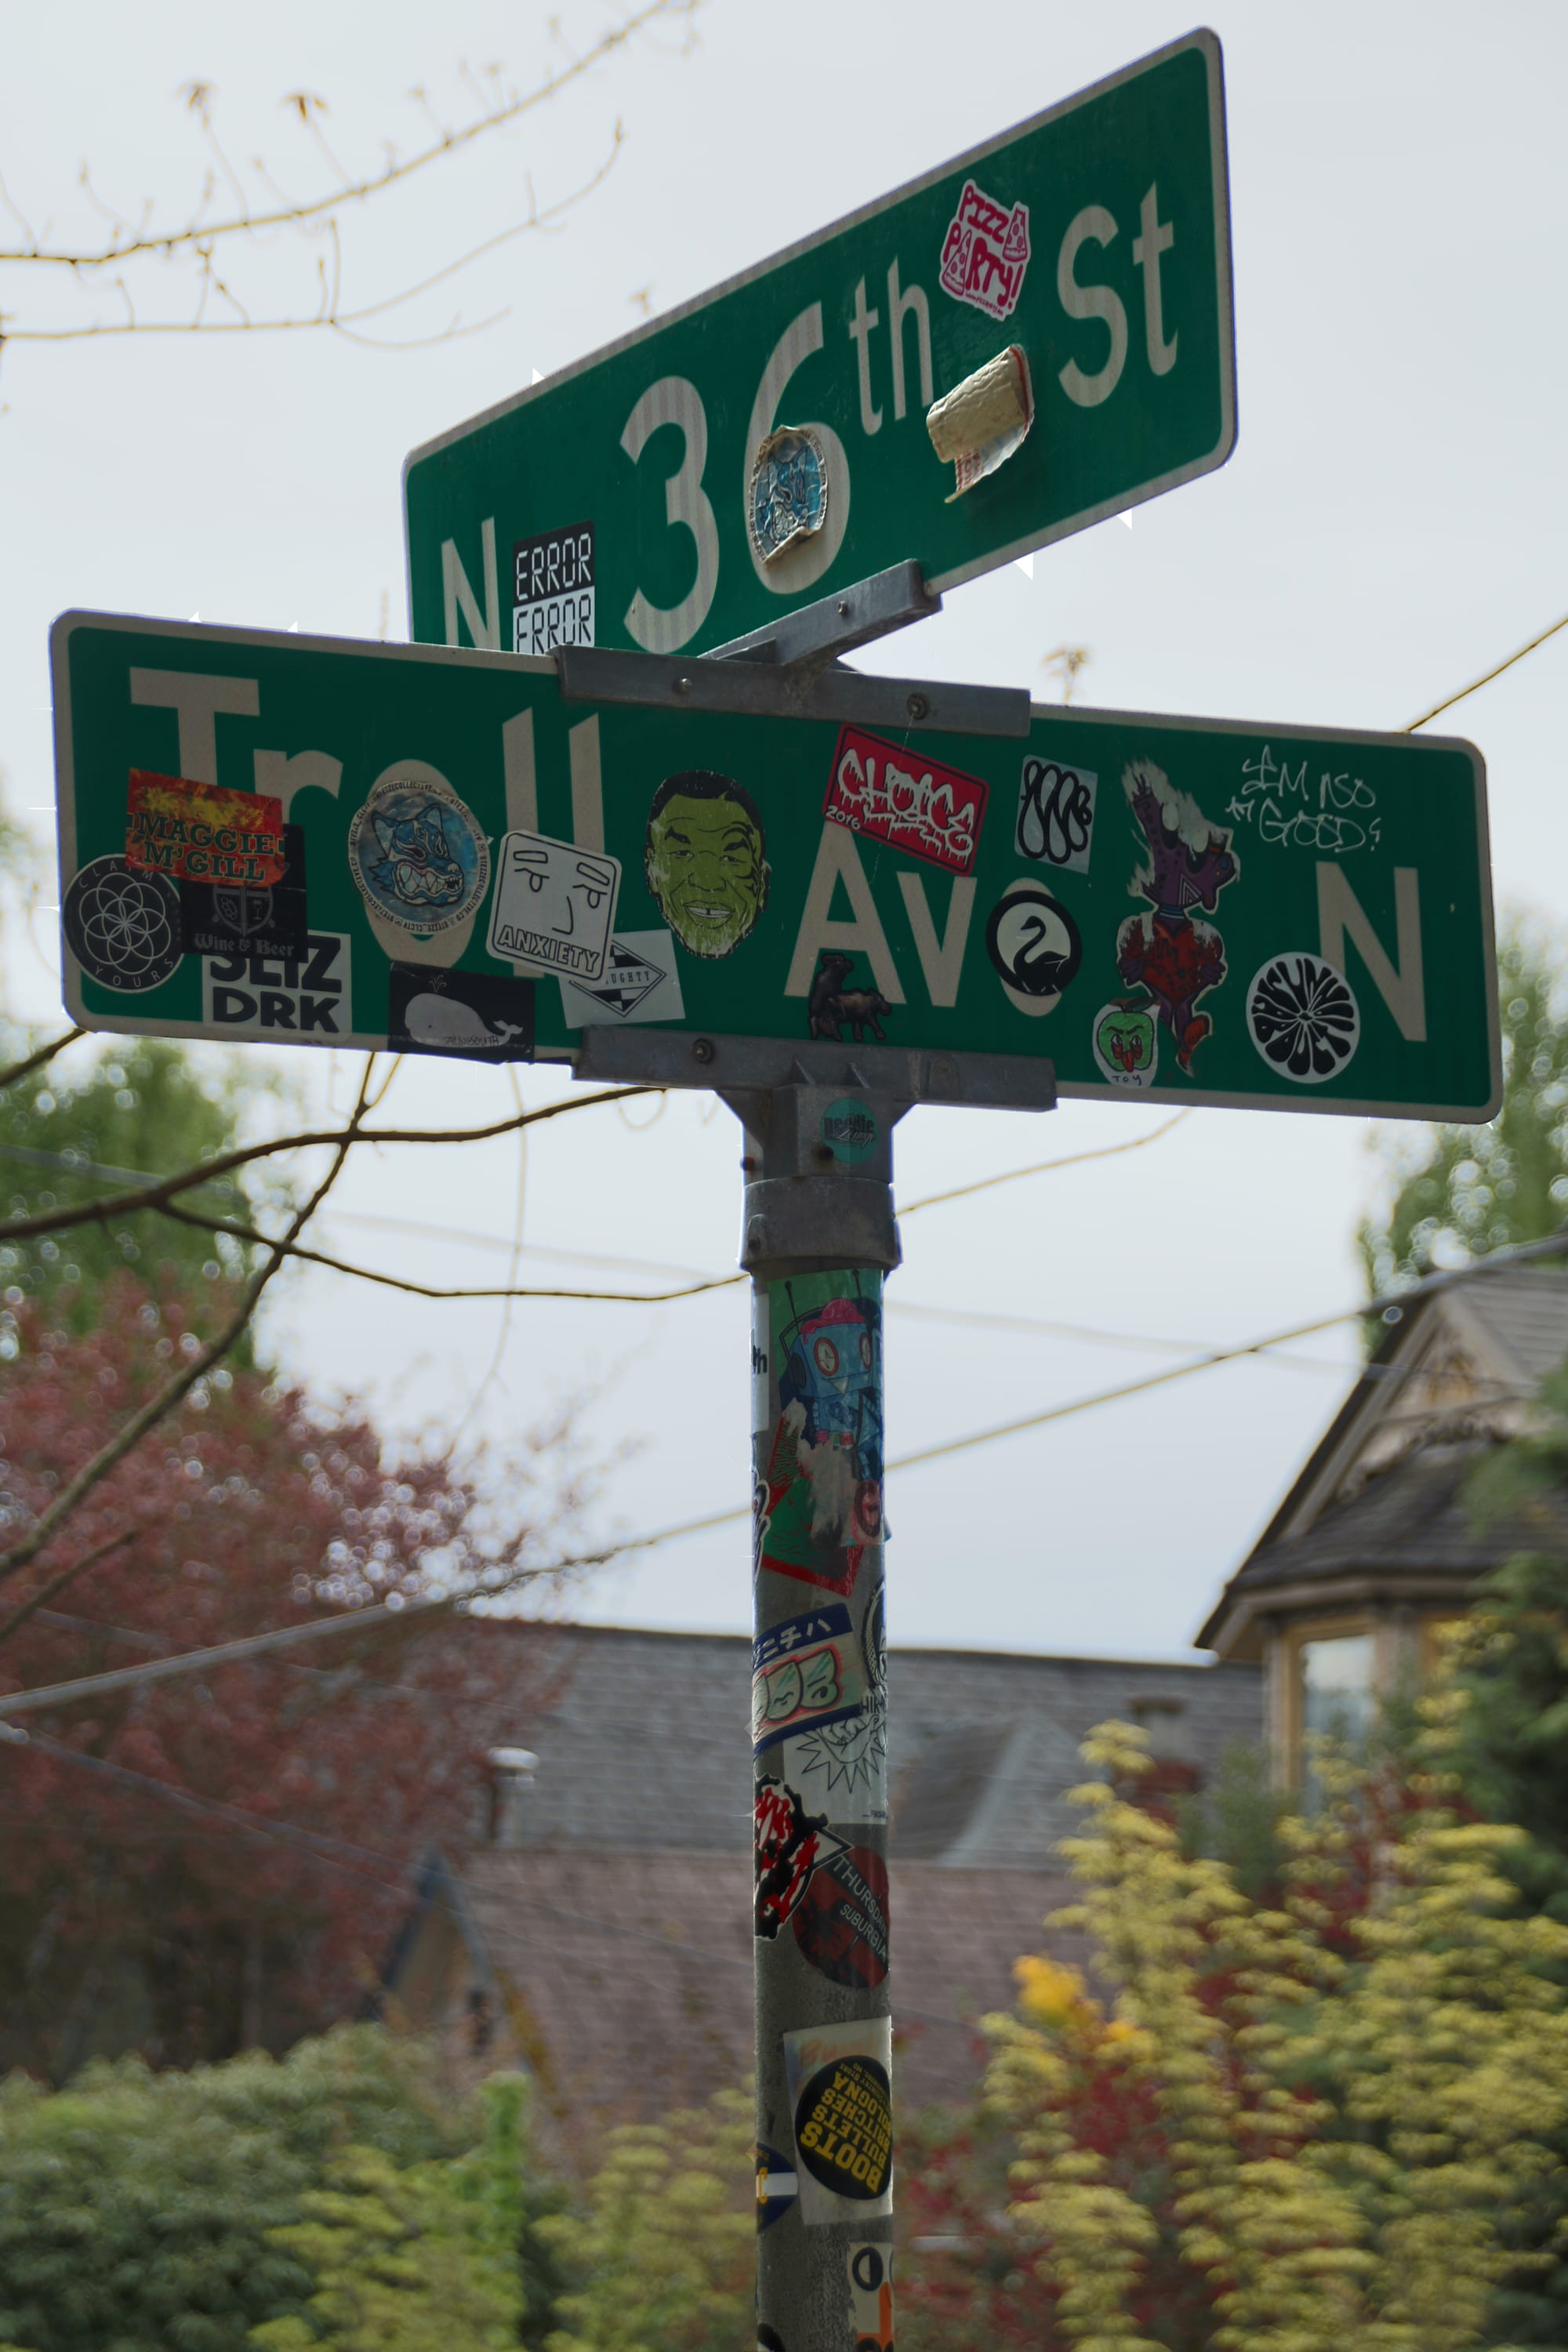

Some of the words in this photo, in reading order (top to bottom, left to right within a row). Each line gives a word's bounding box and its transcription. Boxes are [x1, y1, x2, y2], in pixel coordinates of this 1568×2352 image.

[441, 515, 501, 649] N
[1056, 180, 1178, 408] St
[516, 532, 591, 601] ERROR
[517, 594, 591, 655] ERROR
[137, 812, 276, 857] MAGGIE
[826, 804, 860, 830] 2016
[194, 932, 234, 952] Wine
[238, 937, 251, 952] &
[256, 938, 295, 958] Beer
[497, 924, 600, 972] ANXIETY
[1316, 861, 1427, 1043] N
[95, 957, 174, 989] YOURS
[604, 970, 651, 985] UGHTY
[212, 985, 340, 1033] DRK
[1112, 1075, 1142, 1086] TOY
[811, 2103, 888, 2171] BULLETS
[821, 2087, 891, 2156] BRITCHES
[799, 2120, 884, 2194] BOOTS
